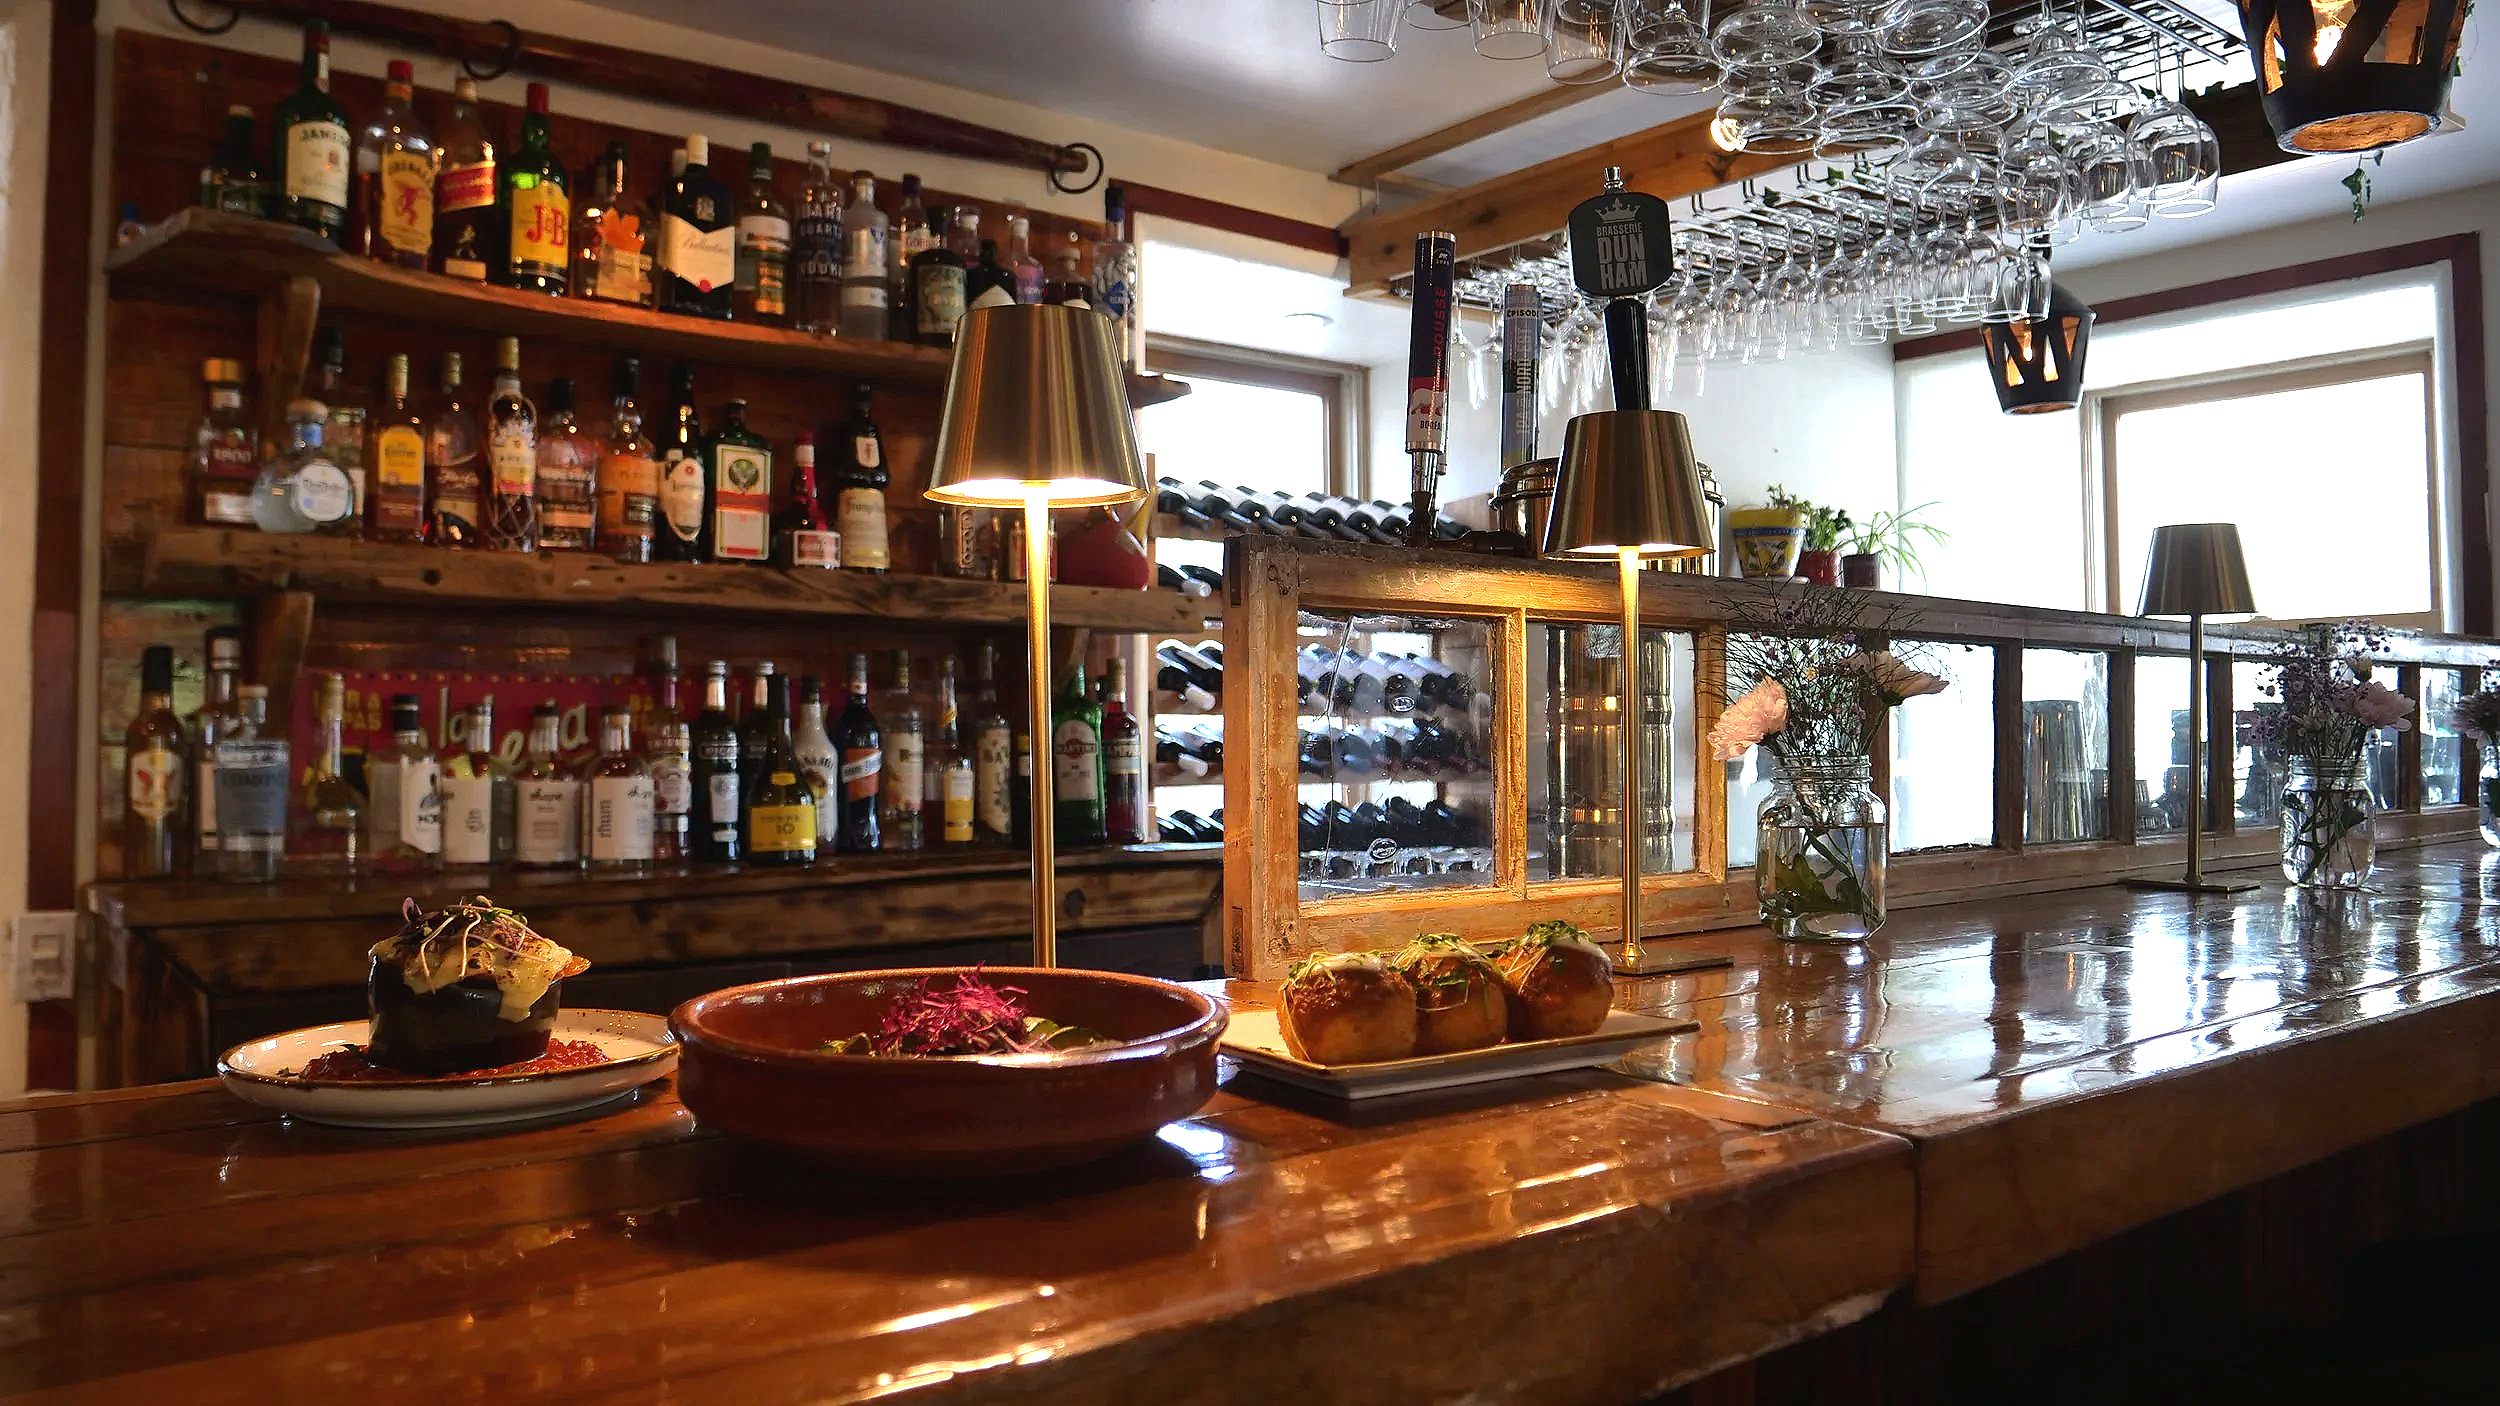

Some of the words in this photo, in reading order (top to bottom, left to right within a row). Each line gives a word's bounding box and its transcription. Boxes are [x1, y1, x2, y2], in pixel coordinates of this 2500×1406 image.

[1597, 223, 1643, 237] BRASSERIE
[1598, 233, 1646, 264] DUN
[1600, 261, 1648, 290] HAM
